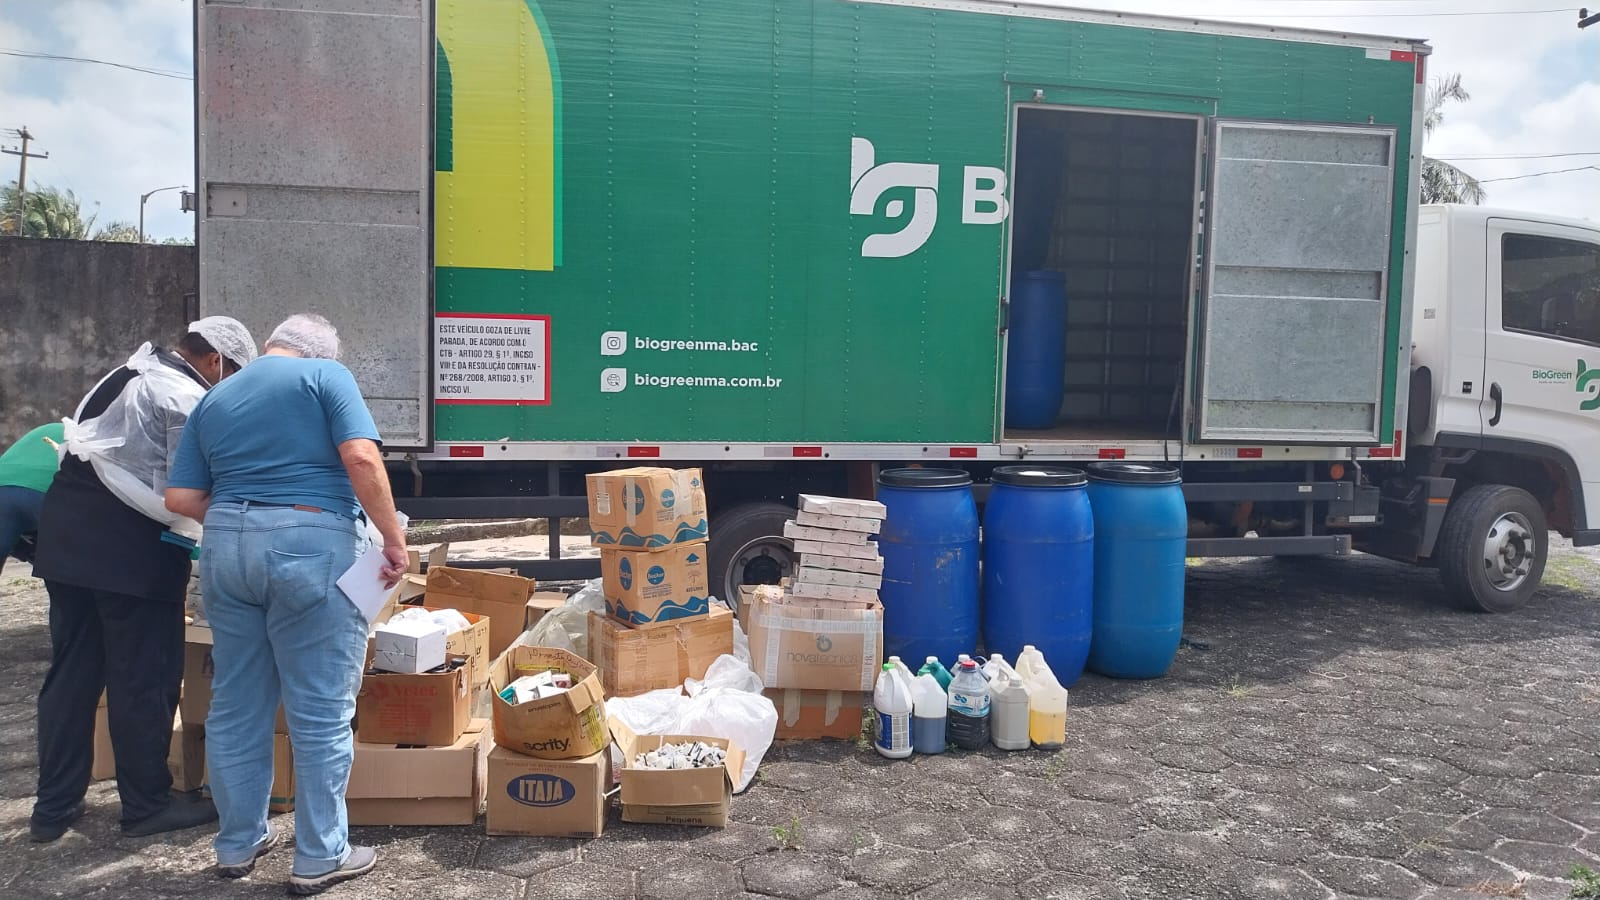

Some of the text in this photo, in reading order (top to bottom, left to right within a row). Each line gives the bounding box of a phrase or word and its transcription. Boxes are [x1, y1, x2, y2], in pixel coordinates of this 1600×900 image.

[440, 324, 456, 333] ESTE
[457, 324, 484, 334] VEÍCULO
[486, 326, 502, 334] GOZA
[504, 326, 512, 334] DE
[440, 337, 468, 346] PARADA,
[479, 338, 505, 346] ACORDO
[635, 336, 758, 352] biogreenma.bac
[484, 350, 494, 358] 29,
[496, 350, 500, 359] §
[468, 361, 505, 371] RESOLUÇÃO
[449, 374, 486, 382] 268/2008,
[521, 375, 525, 383] §
[1532, 370, 1572, 379] BioGreen
[634, 374, 782, 388] biogreenma.com.br
[519, 776, 564, 802] ITAJÁ
